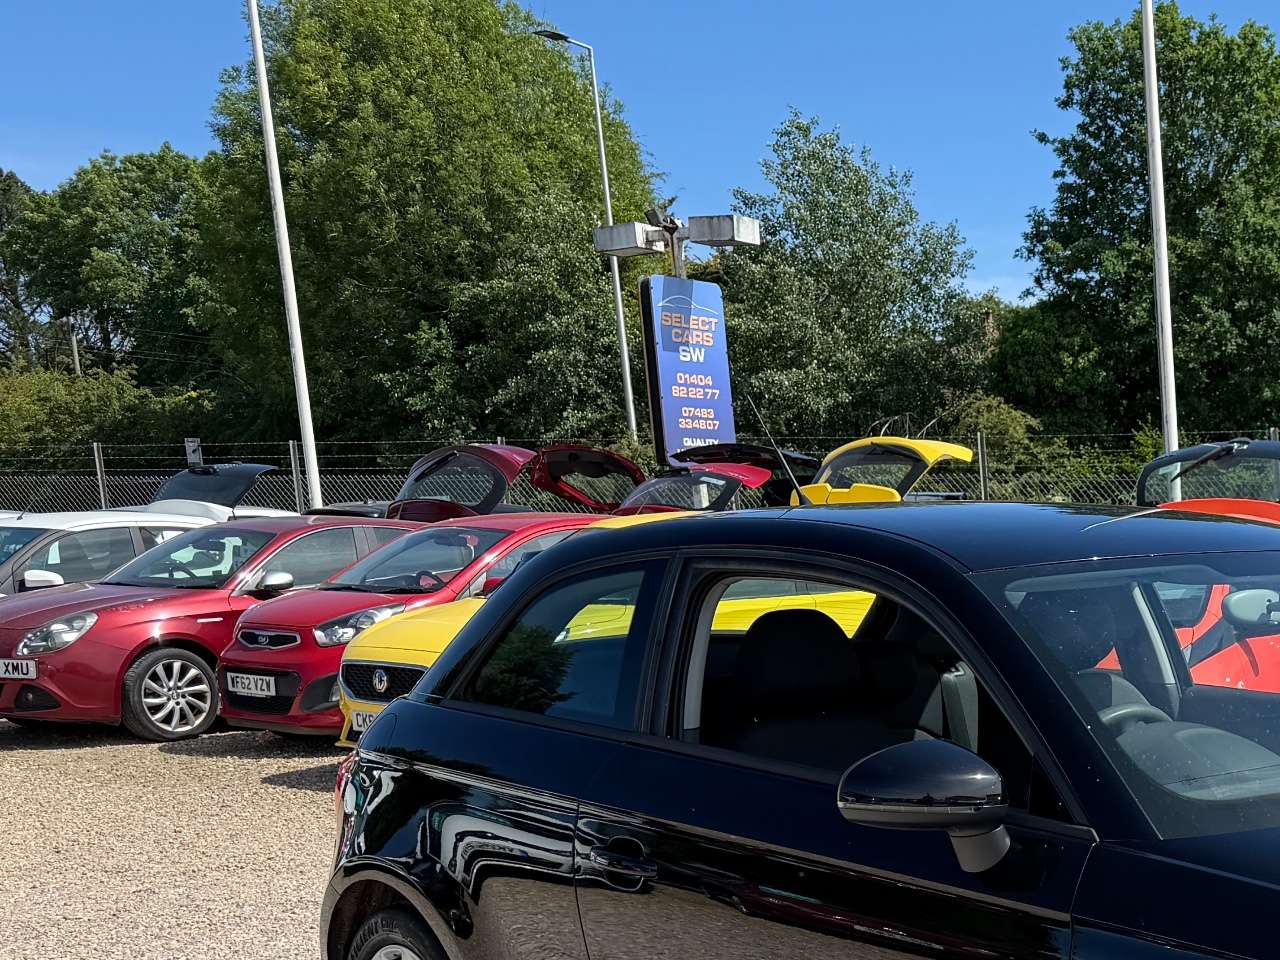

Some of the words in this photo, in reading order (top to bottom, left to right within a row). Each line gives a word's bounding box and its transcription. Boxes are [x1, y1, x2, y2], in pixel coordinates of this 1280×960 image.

[662, 312, 718, 331] SELECT
[671, 328, 714, 346] CARS
[679, 346, 705, 362] SW
[676, 373, 713, 386] 01404
[3, 661, 29, 676] XMU
[229, 674, 252, 690] WF62
